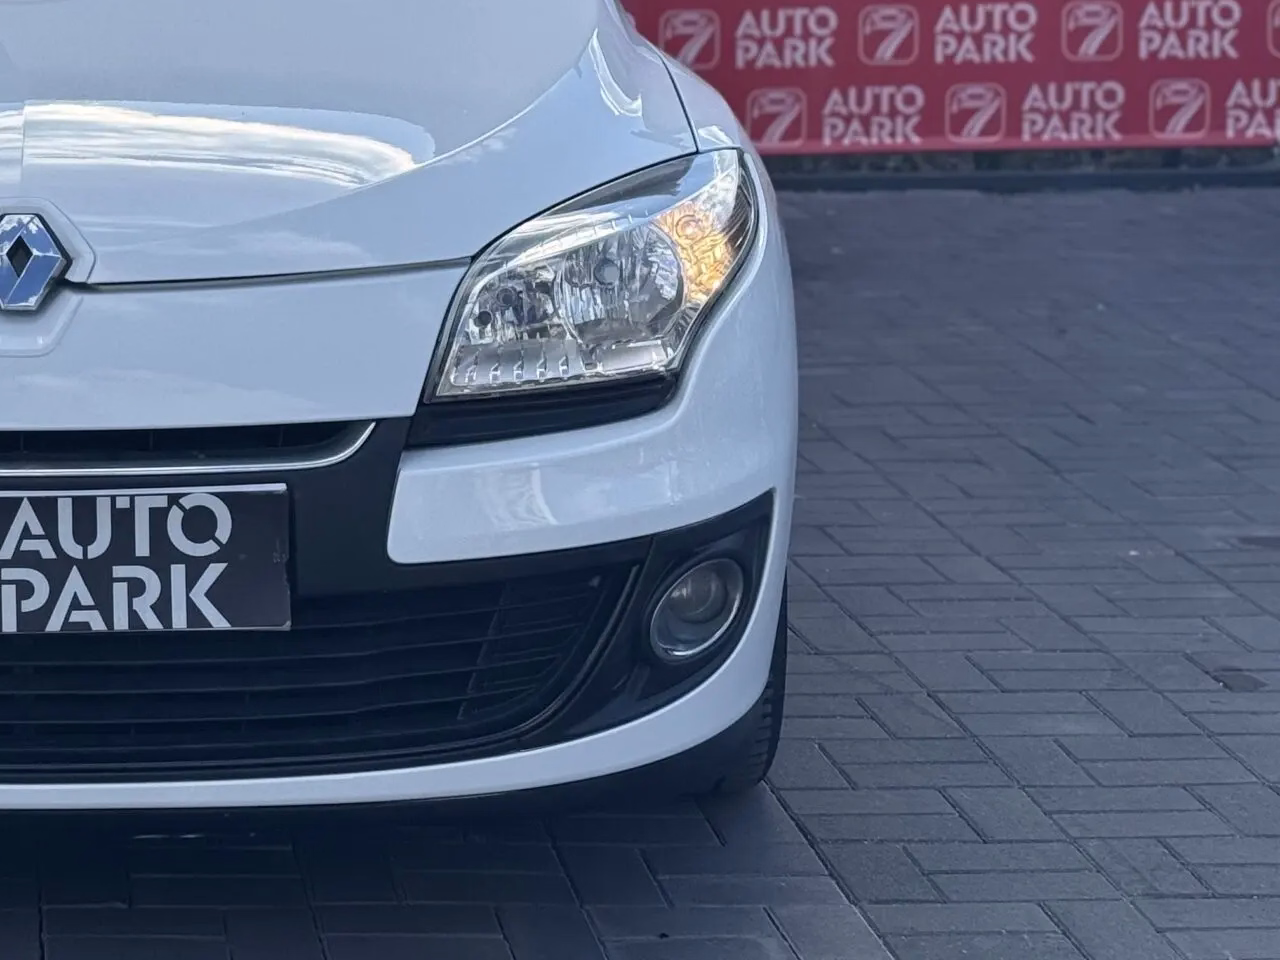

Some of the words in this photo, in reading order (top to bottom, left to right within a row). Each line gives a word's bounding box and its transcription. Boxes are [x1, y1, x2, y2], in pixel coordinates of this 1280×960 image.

[736, 6, 838, 39] AUTO
[935, 2, 1037, 32] AUTO
[736, 35, 834, 68] PARK
[935, 33, 1034, 63] PARK
[1139, 29, 1238, 59] PARK
[823, 85, 924, 117] AUTO
[1022, 81, 1125, 111] AUTO
[822, 116, 920, 147] PARK
[1022, 112, 1121, 142] PARK
[1, 562, 231, 633] PARK
